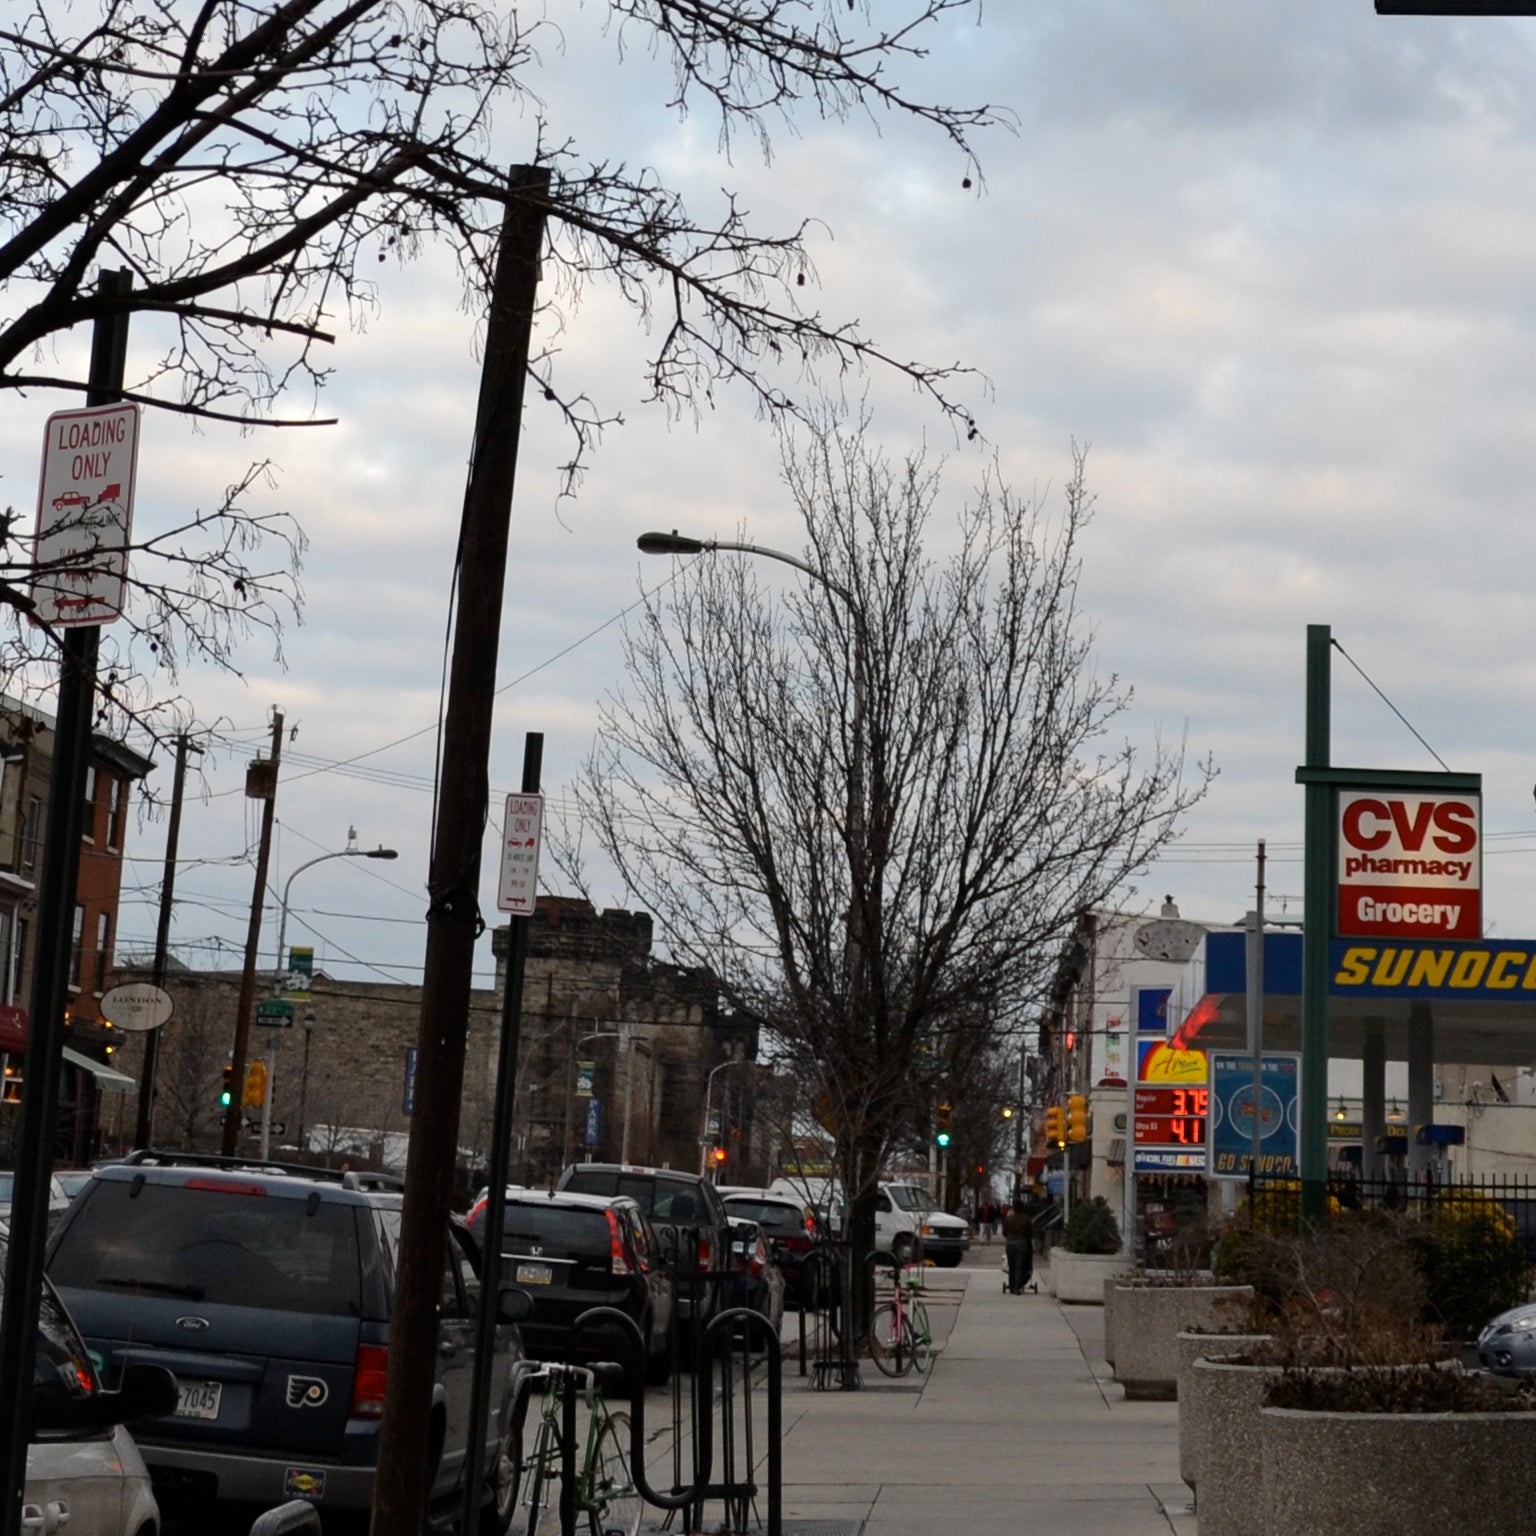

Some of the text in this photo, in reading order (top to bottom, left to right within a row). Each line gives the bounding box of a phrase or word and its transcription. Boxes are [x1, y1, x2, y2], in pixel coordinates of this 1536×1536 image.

[58, 416, 126, 450] LOADING
[71, 451, 112, 481] ONLY
[509, 799, 538, 816] LOADING
[514, 817, 531, 833] ONLY
[1342, 798, 1478, 854] CVS
[1345, 853, 1473, 881] pharmacy
[1357, 896, 1462, 930] Grocery
[112, 996, 162, 1005] LONDON
[1218, 1153, 1237, 1171] GO
